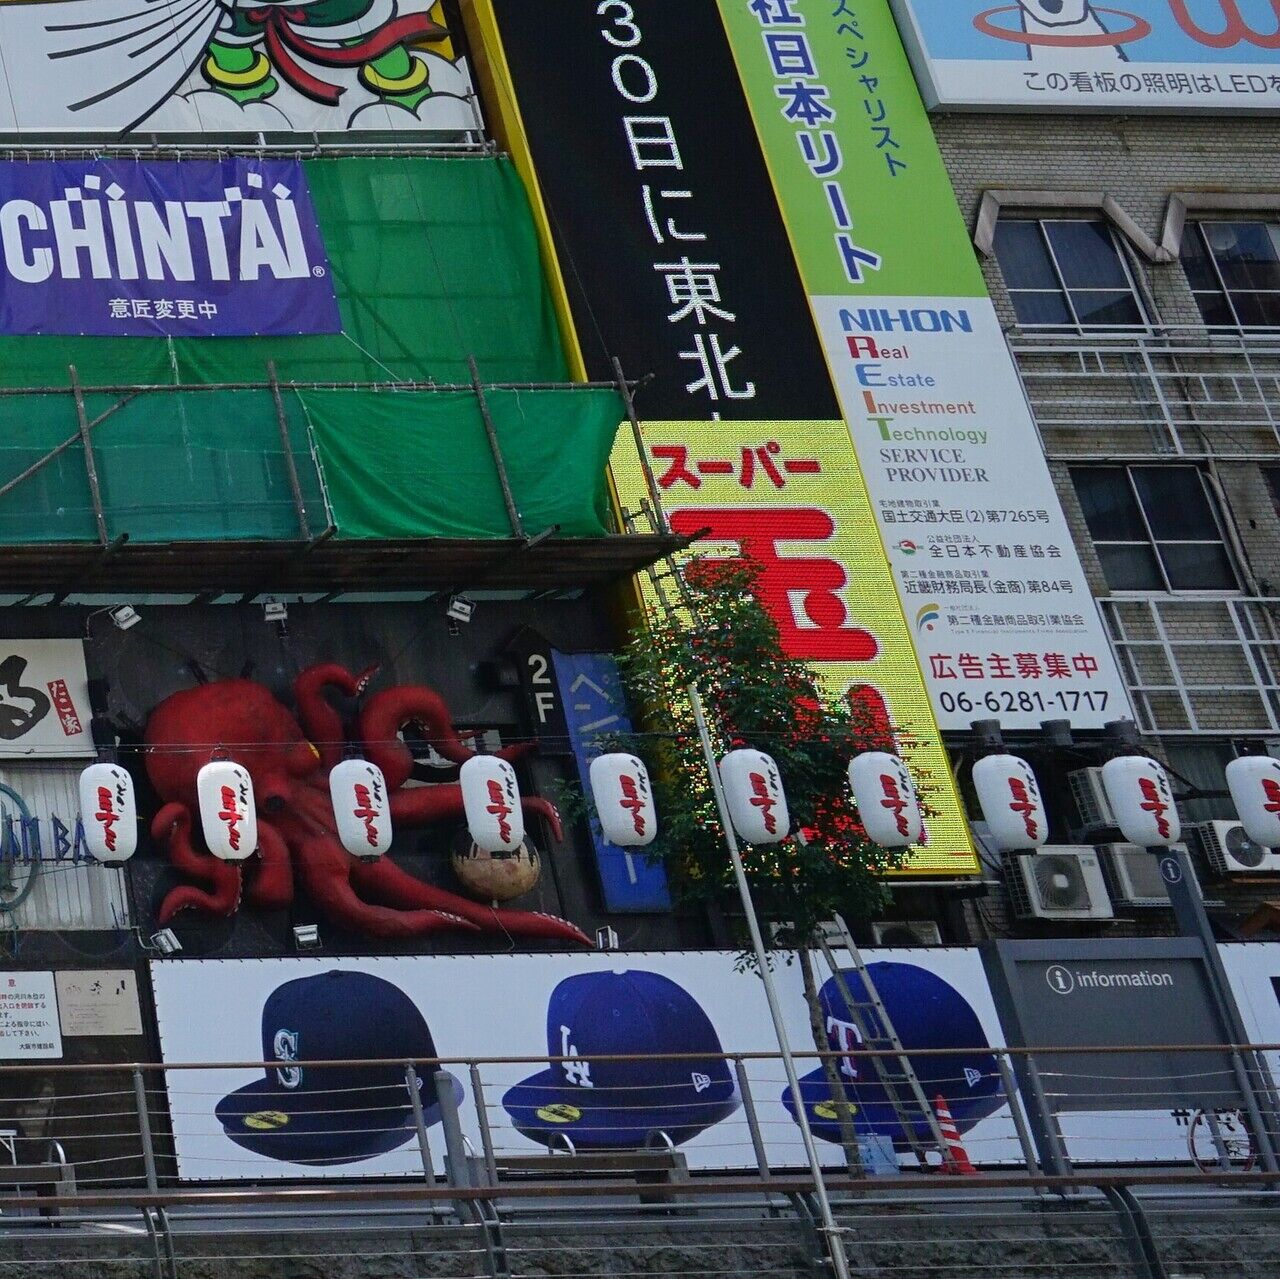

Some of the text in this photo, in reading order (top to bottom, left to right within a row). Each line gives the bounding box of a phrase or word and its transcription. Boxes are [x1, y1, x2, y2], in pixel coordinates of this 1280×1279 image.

[108, 297, 219, 322] 意匠変更中
[839, 308, 973, 334] NIHON
[847, 335, 910, 360] Real
[856, 362, 936, 388] Estate
[862, 390, 977, 415] Investment
[866, 417, 989, 446] Technology
[651, 442, 822, 489] スーパー
[879, 448, 967, 465] SERVICE
[886, 467, 990, 484] PROVIDER
[929, 545, 1062, 558] 全日本不動産協会
[929, 653, 1099, 680] 広告主募集中
[940, 691, 1110, 713] 06-6281-1717
[51, 810, 96, 867] BA
[1076, 970, 1174, 988] information
